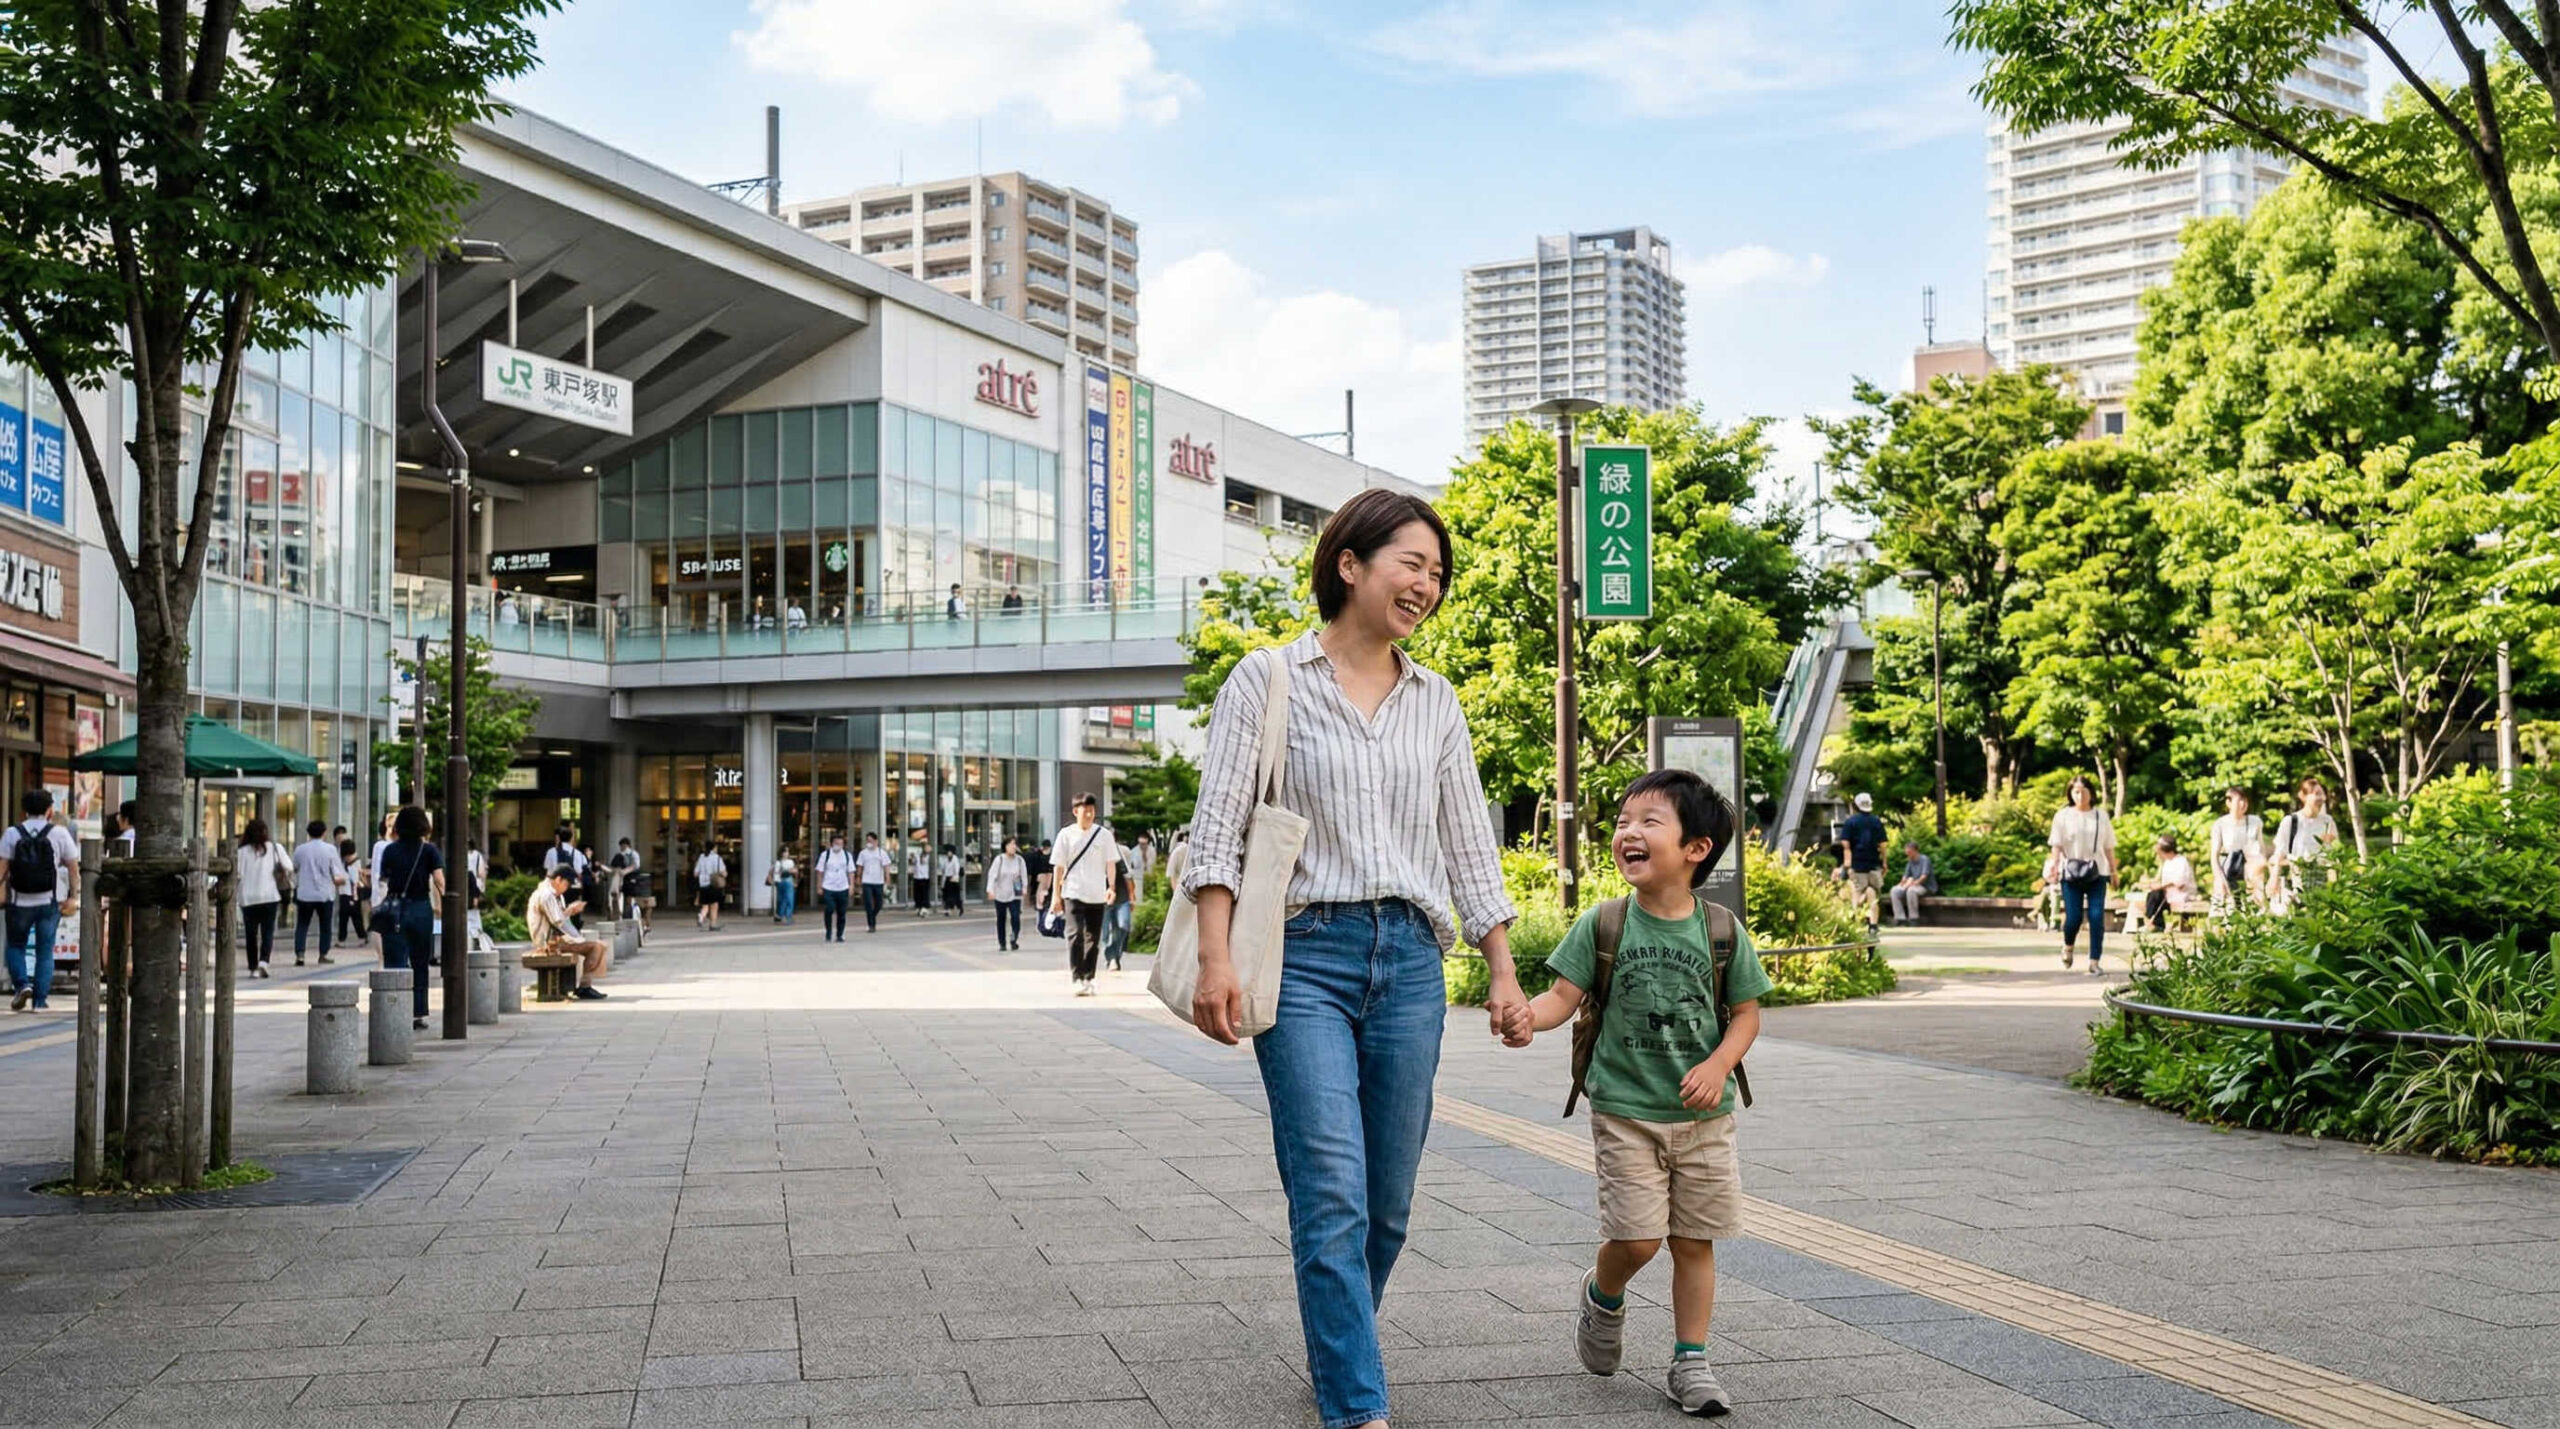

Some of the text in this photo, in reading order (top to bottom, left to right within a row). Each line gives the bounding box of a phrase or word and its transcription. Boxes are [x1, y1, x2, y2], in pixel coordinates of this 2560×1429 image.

[497, 357, 532, 390] JR
[543, 366, 618, 409] 東戸塚駅
[977, 357, 1039, 414] atré
[1169, 432, 1216, 482] atré
[32, 483, 60, 508] カフェ
[1599, 462, 1632, 606] 緑の公園
